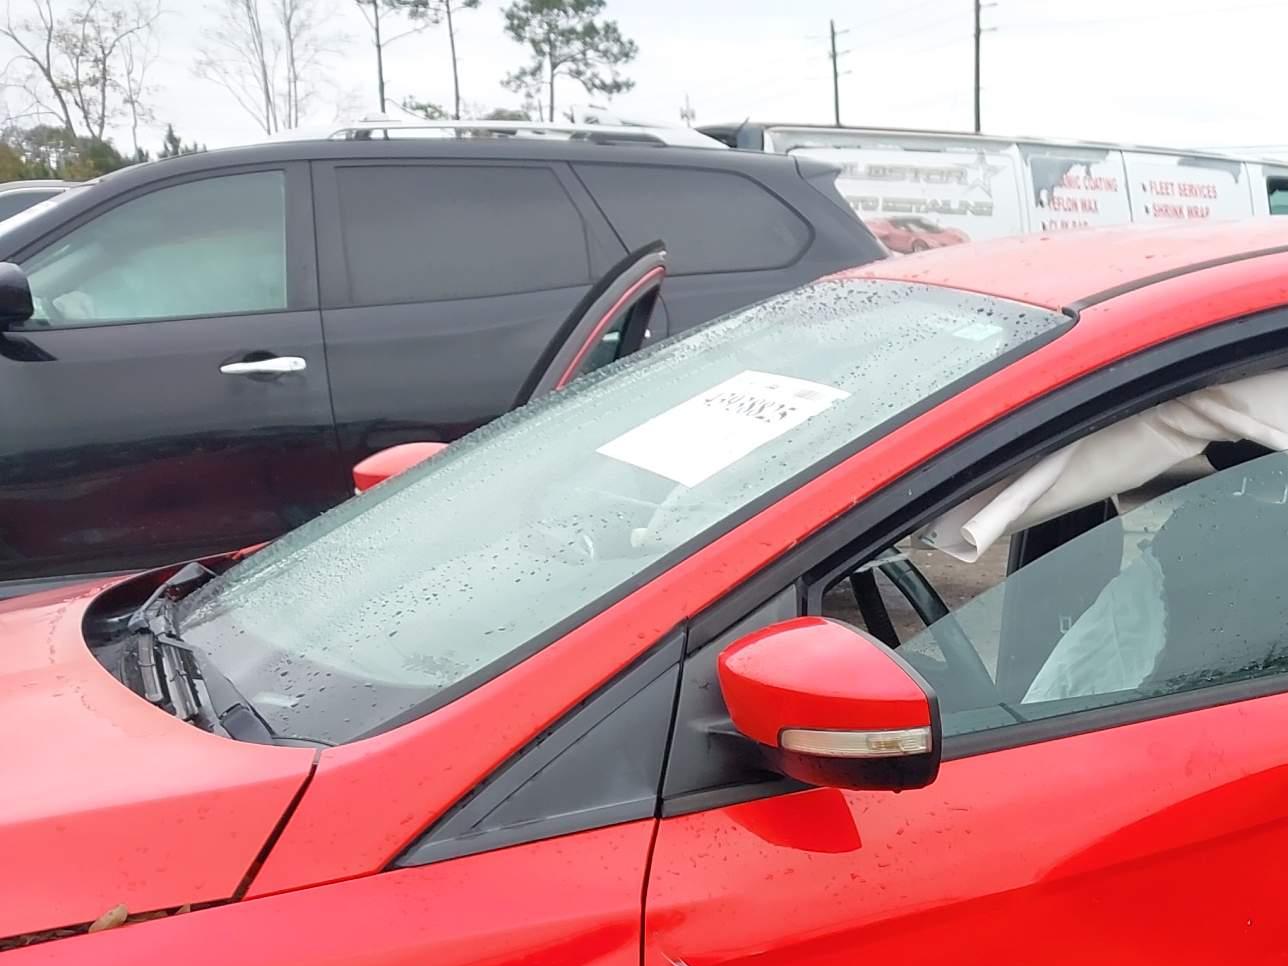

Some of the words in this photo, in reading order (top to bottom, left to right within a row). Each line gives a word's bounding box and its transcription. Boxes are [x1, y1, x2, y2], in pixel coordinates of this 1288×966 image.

[1149, 180, 1175, 196] FLEET
[1177, 183, 1217, 199] SERVICES
[1152, 202, 1184, 218] SHRINK
